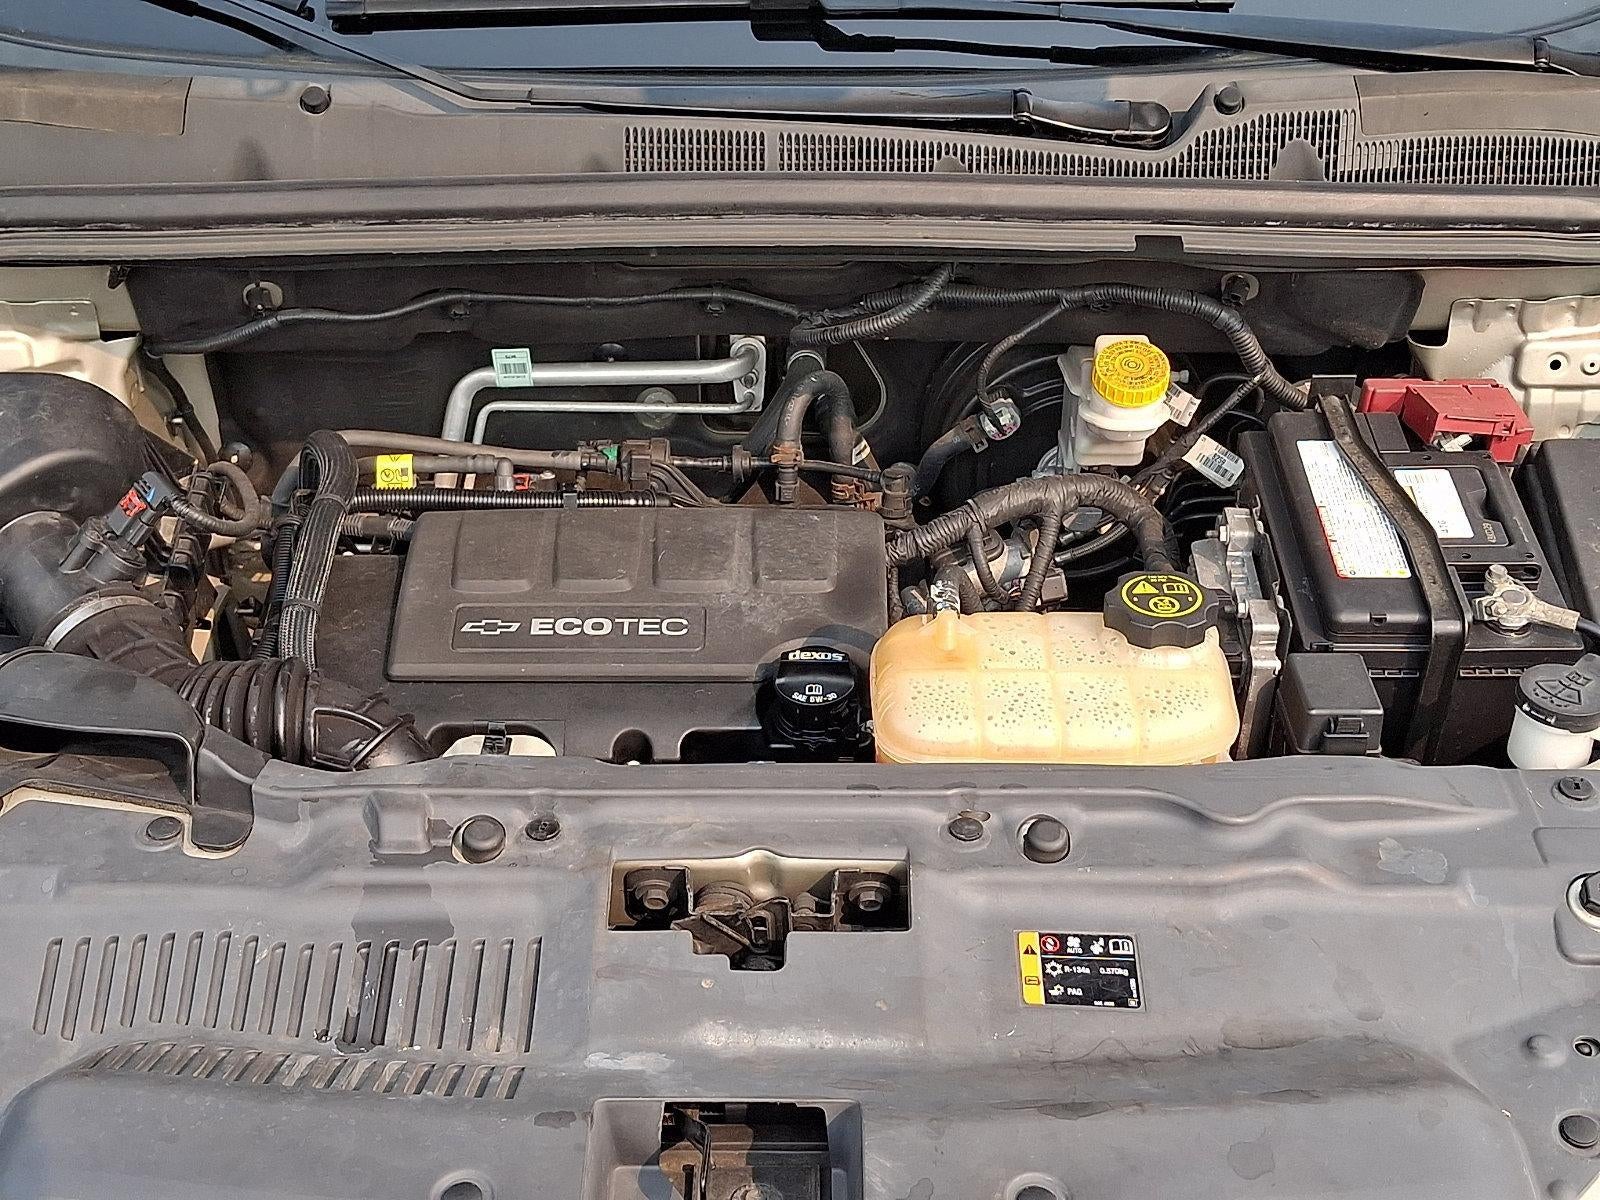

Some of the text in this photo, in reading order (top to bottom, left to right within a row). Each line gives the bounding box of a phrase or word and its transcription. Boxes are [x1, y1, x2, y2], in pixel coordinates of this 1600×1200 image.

[530, 617, 689, 636] ECOTEC
[788, 650, 846, 661] dexos
[792, 691, 838, 703] SAE 5W-30
[1063, 965, 1091, 974] R-134a
